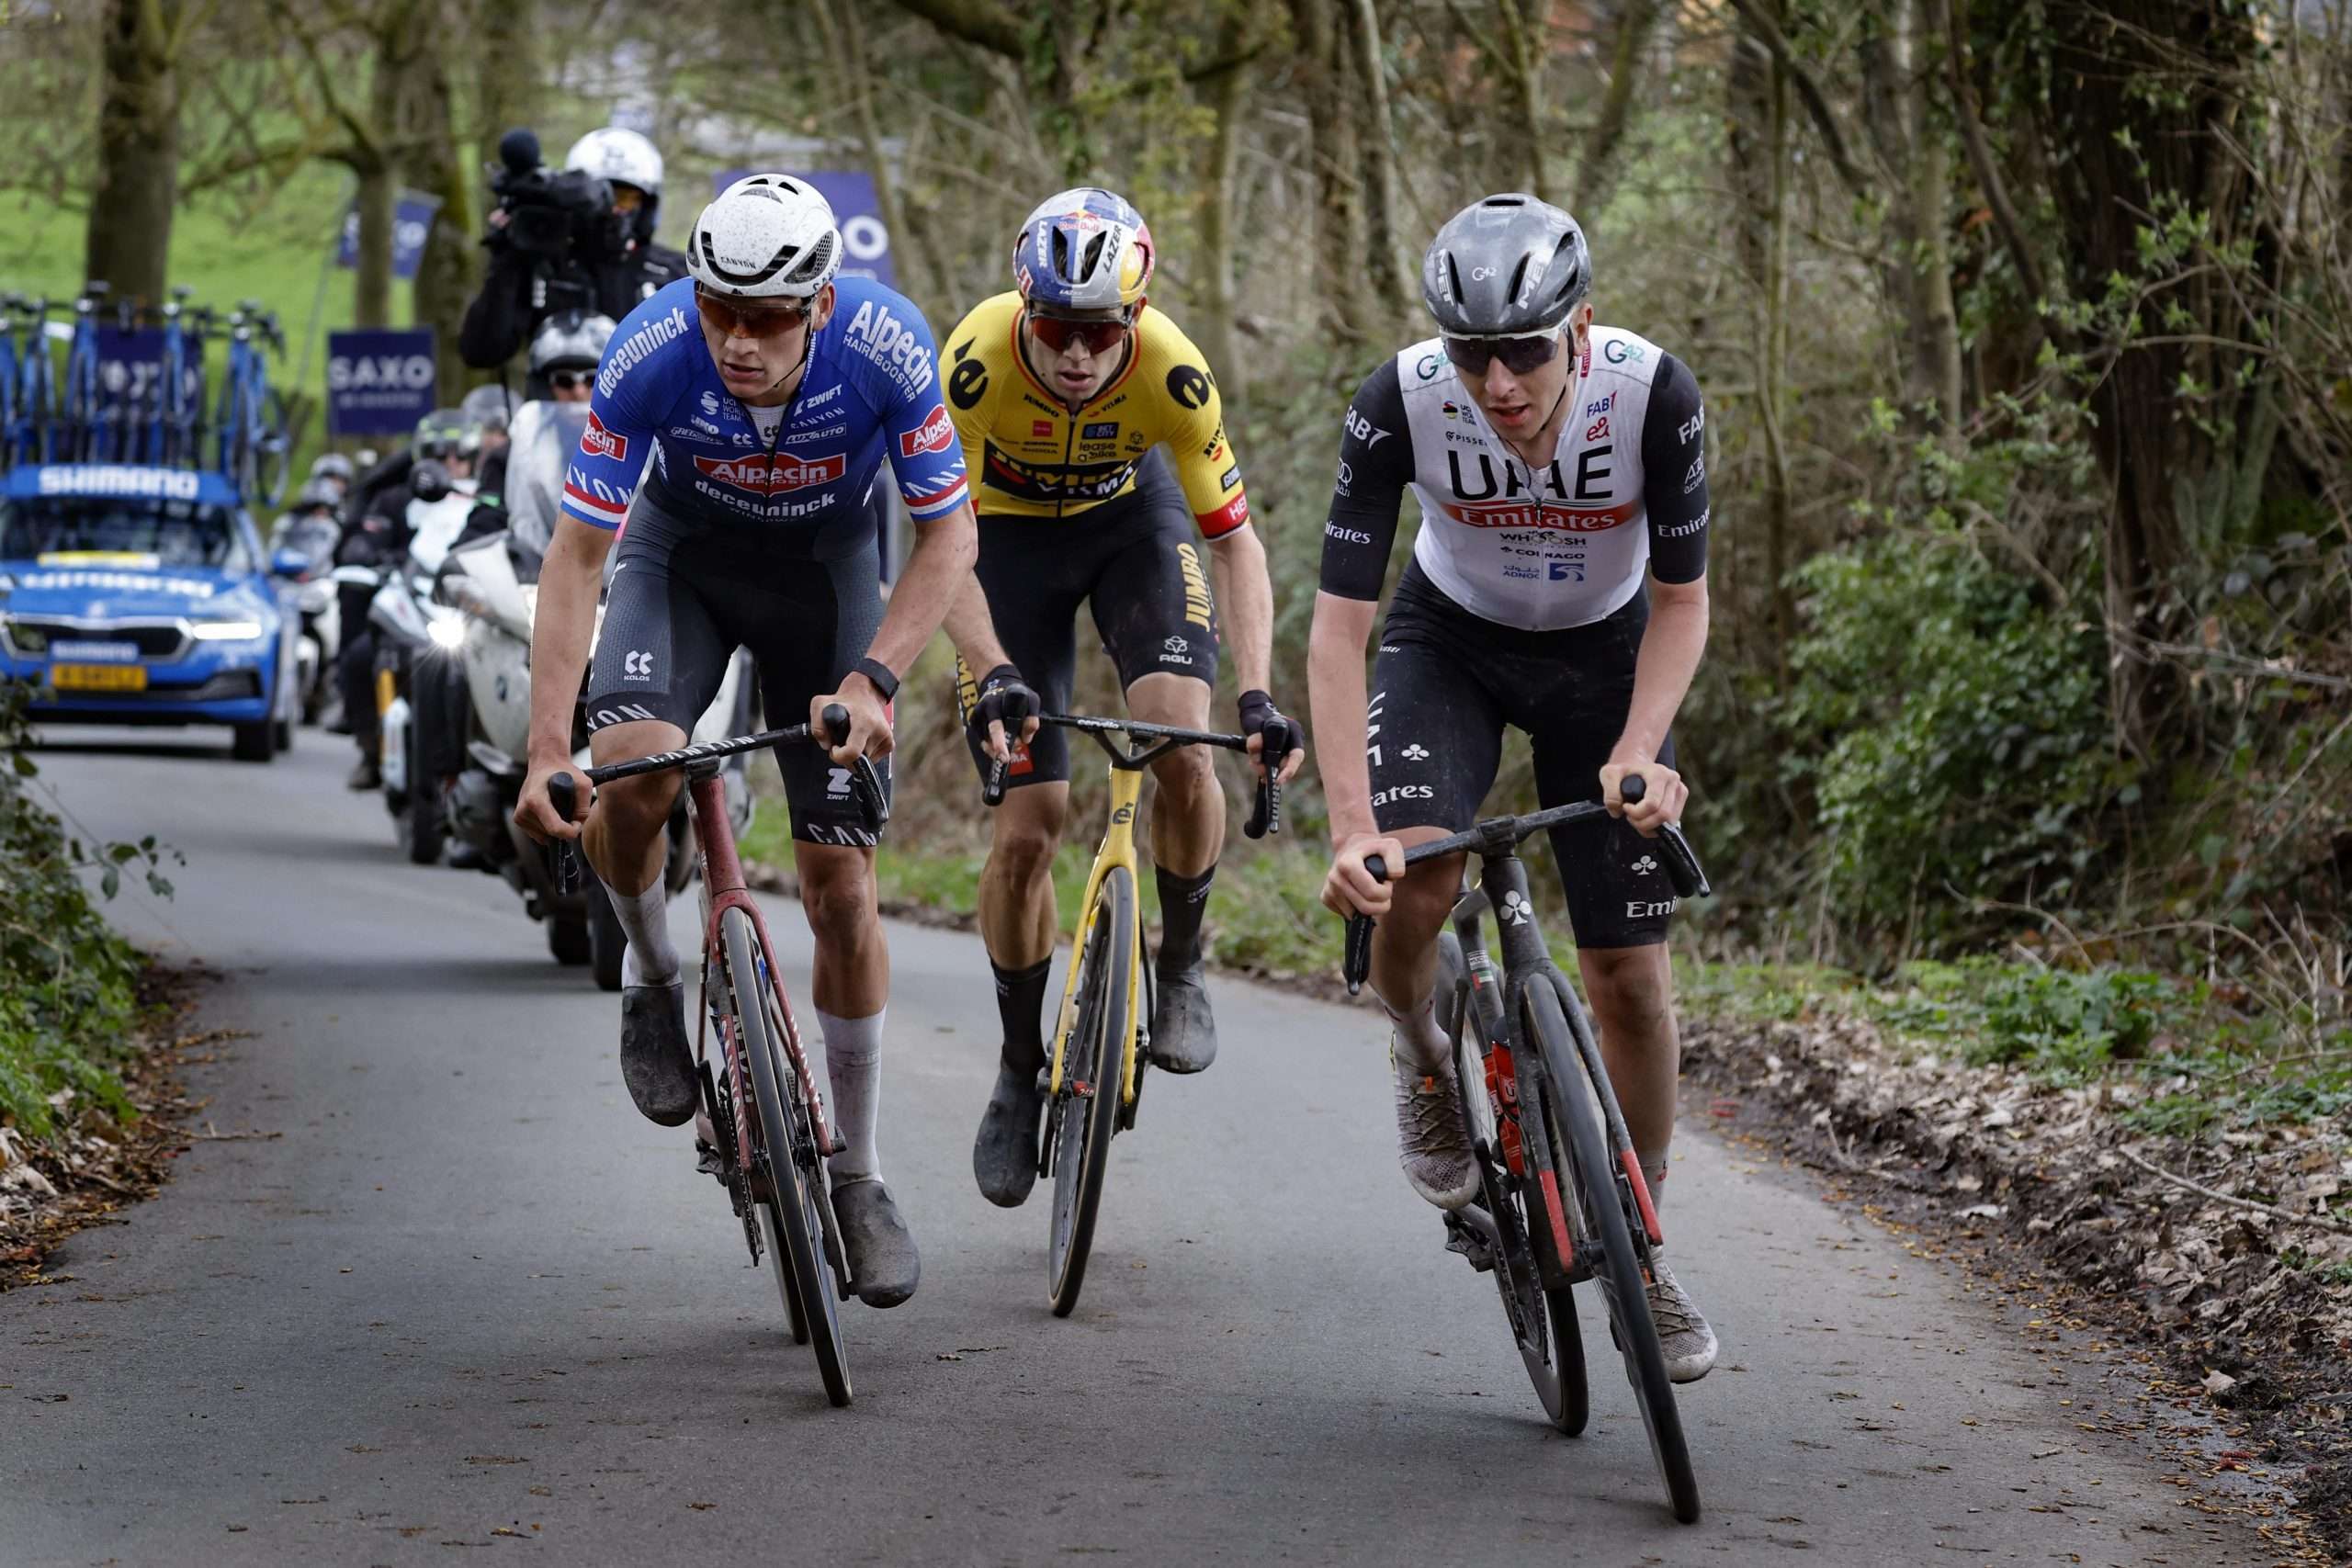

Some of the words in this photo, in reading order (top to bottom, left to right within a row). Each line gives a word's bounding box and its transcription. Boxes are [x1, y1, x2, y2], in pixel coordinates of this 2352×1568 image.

[1036, 220, 1048, 268] LAZER
[1102, 225, 1123, 274] LAZER
[720, 256, 757, 269] CANYON
[1437, 249, 1455, 307] MET
[1472, 266, 1498, 281] G42
[598, 307, 689, 399] deceuninck
[847, 300, 933, 395] Alpecin
[1605, 340, 1645, 364] G42
[330, 355, 435, 390] SAXO
[843, 334, 871, 359] HAIR
[875, 355, 917, 403] BOOSTER
[807, 384, 842, 409] ZWIFT
[790, 407, 845, 429] CANYON
[1079, 442, 1116, 451] lease
[39, 466, 198, 499] SHIMANO
[711, 463, 827, 484] Alpecin
[1448, 445, 1613, 501] UAE
[695, 479, 836, 517] deceuninck
[1462, 507, 1616, 529] Emirates
[1177, 543, 1211, 632] JUMBO
[1159, 655, 1193, 664] AGU
[647, 736, 756, 763] CANYON
